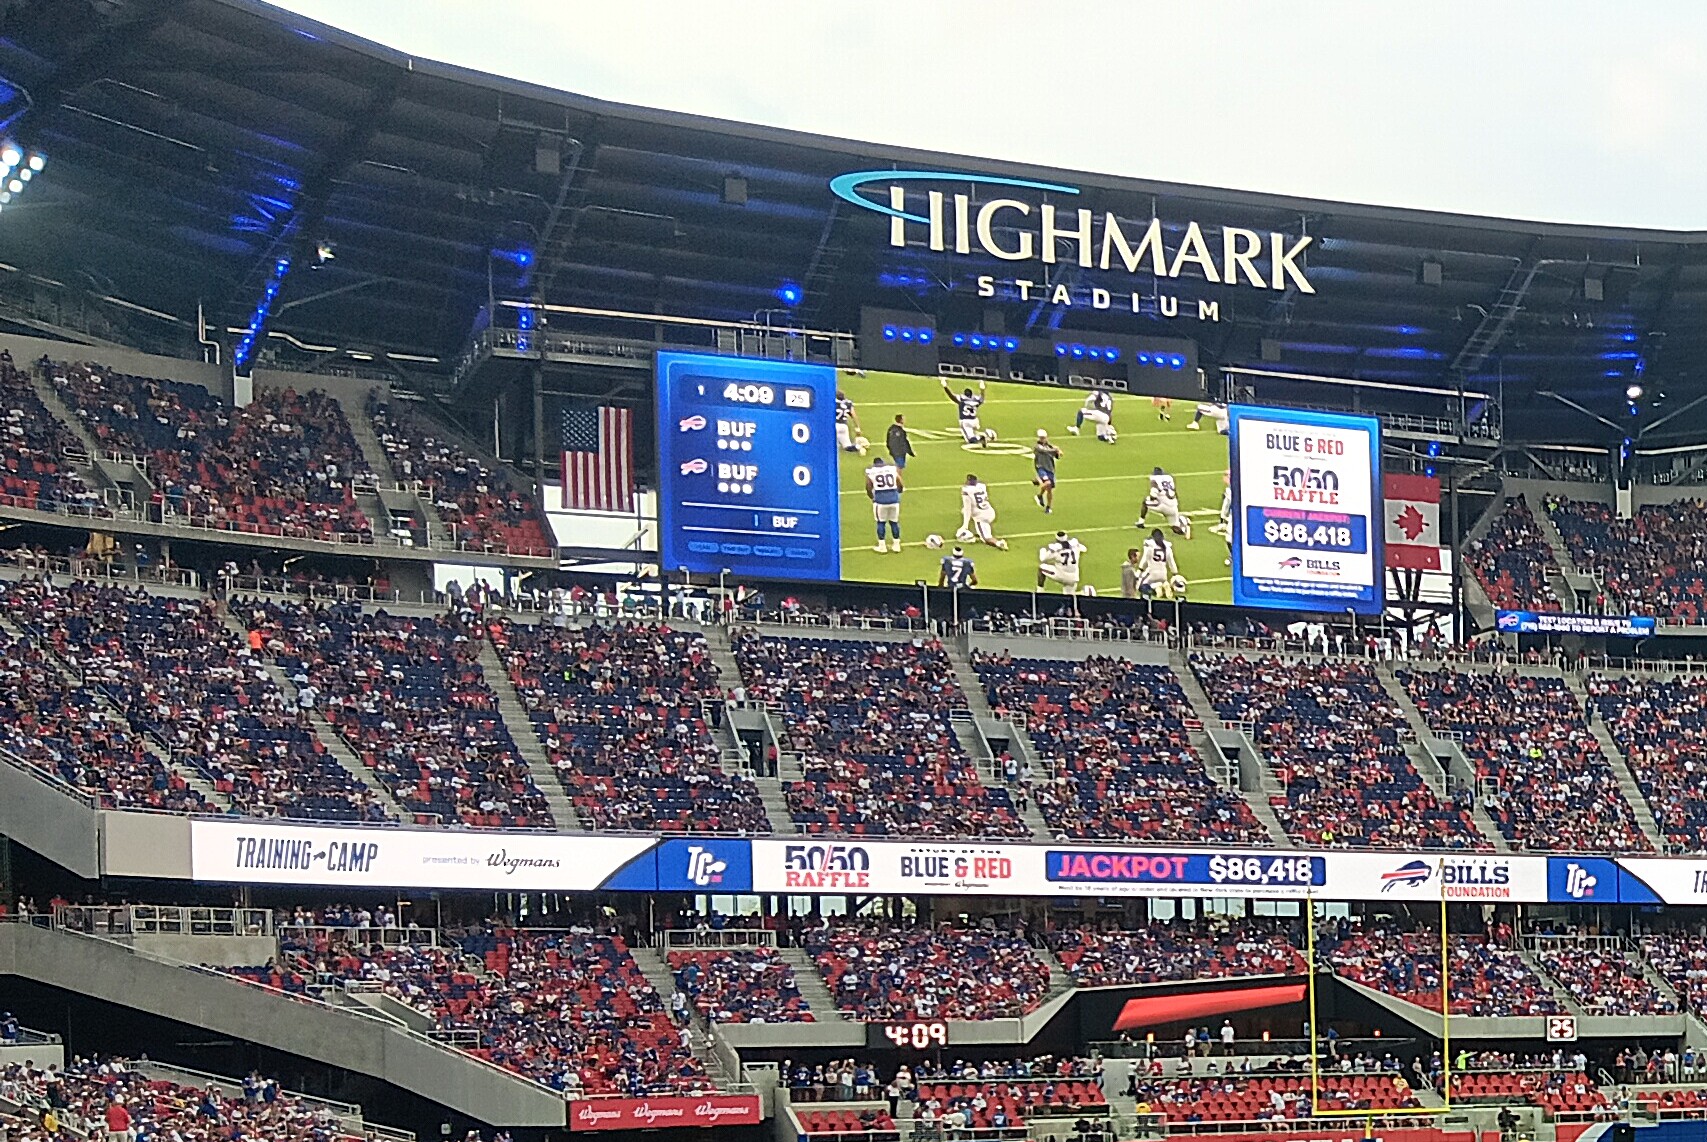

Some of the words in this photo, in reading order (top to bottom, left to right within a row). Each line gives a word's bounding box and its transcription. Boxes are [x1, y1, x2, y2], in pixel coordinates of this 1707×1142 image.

[890, 185, 1315, 294] HIGHMARK
[977, 275, 1220, 322] STADIUM
[723, 383, 774, 404] 4:09
[717, 420, 757, 437] BUF
[792, 423, 810, 443] 0
[1266, 433, 1299, 452] BLUE
[1317, 438, 1344, 455] RED
[718, 463, 758, 480] BUF
[793, 466, 811, 486] 0
[875, 474, 895, 488] 90
[1273, 465, 1339, 491] 50/50
[1273, 487, 1339, 505] RAFFLE
[773, 516, 798, 528] BUF
[1264, 520, 1351, 546] $86,418
[1306, 559, 1340, 571] BILLS
[235, 837, 311, 869] TRAINING
[327, 843, 378, 872] CAMP
[485, 848, 560, 875] Wegmans
[785, 845, 869, 871] 50/50
[901, 856, 949, 878] BLUE
[954, 857, 968, 878] &
[974, 857, 1012, 879] RED
[1058, 854, 1189, 879] JACKPOT
[1208, 854, 1313, 884] $86,418
[1442, 866, 1509, 884] BILLS
[785, 871, 869, 888] RAFFLE
[885, 1023, 946, 1048] 4:09
[1551, 1019, 1573, 1038] 25
